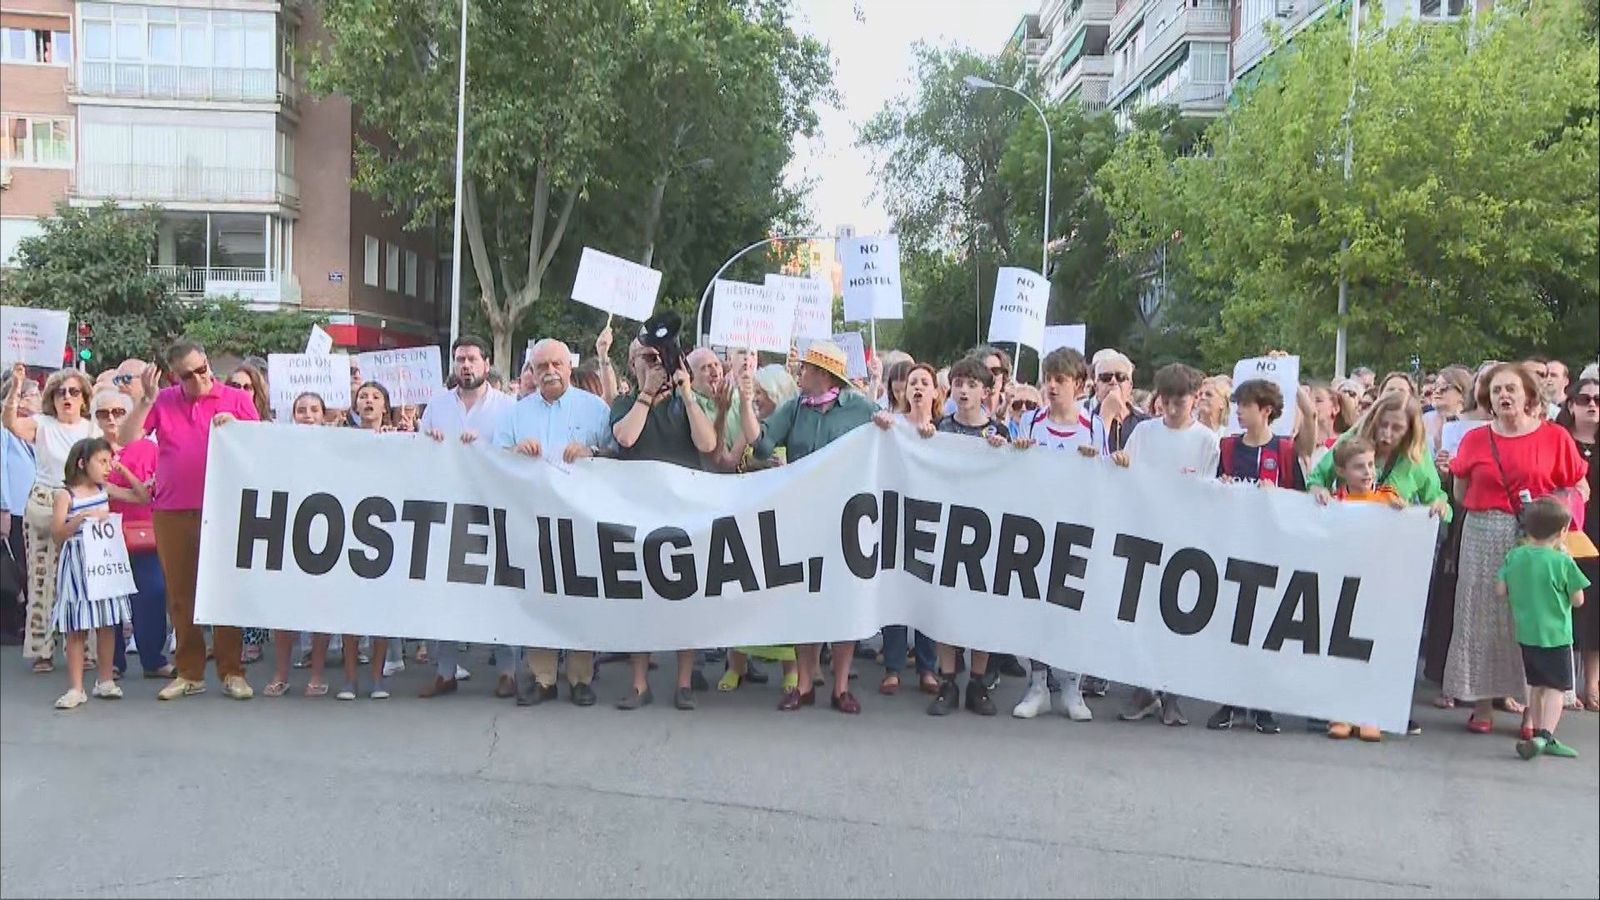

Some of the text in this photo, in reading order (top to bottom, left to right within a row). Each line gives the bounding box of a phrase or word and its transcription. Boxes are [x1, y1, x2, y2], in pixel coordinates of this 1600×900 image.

[860, 244, 879, 254] NO
[864, 261, 877, 271] AL
[849, 277, 893, 288] HOSTEL
[1016, 276, 1035, 289] NO
[1017, 292, 1029, 302] AL
[1000, 304, 1040, 321] HOSTEL
[374, 353, 391, 365] NO
[1256, 361, 1276, 372] NO
[92, 522, 115, 540] NO
[103, 547, 113, 558] AL
[87, 562, 130, 577] HOSTEL
[236, 488, 1374, 663] HOSTEL ILEGAL, CIERRE TOTAL
